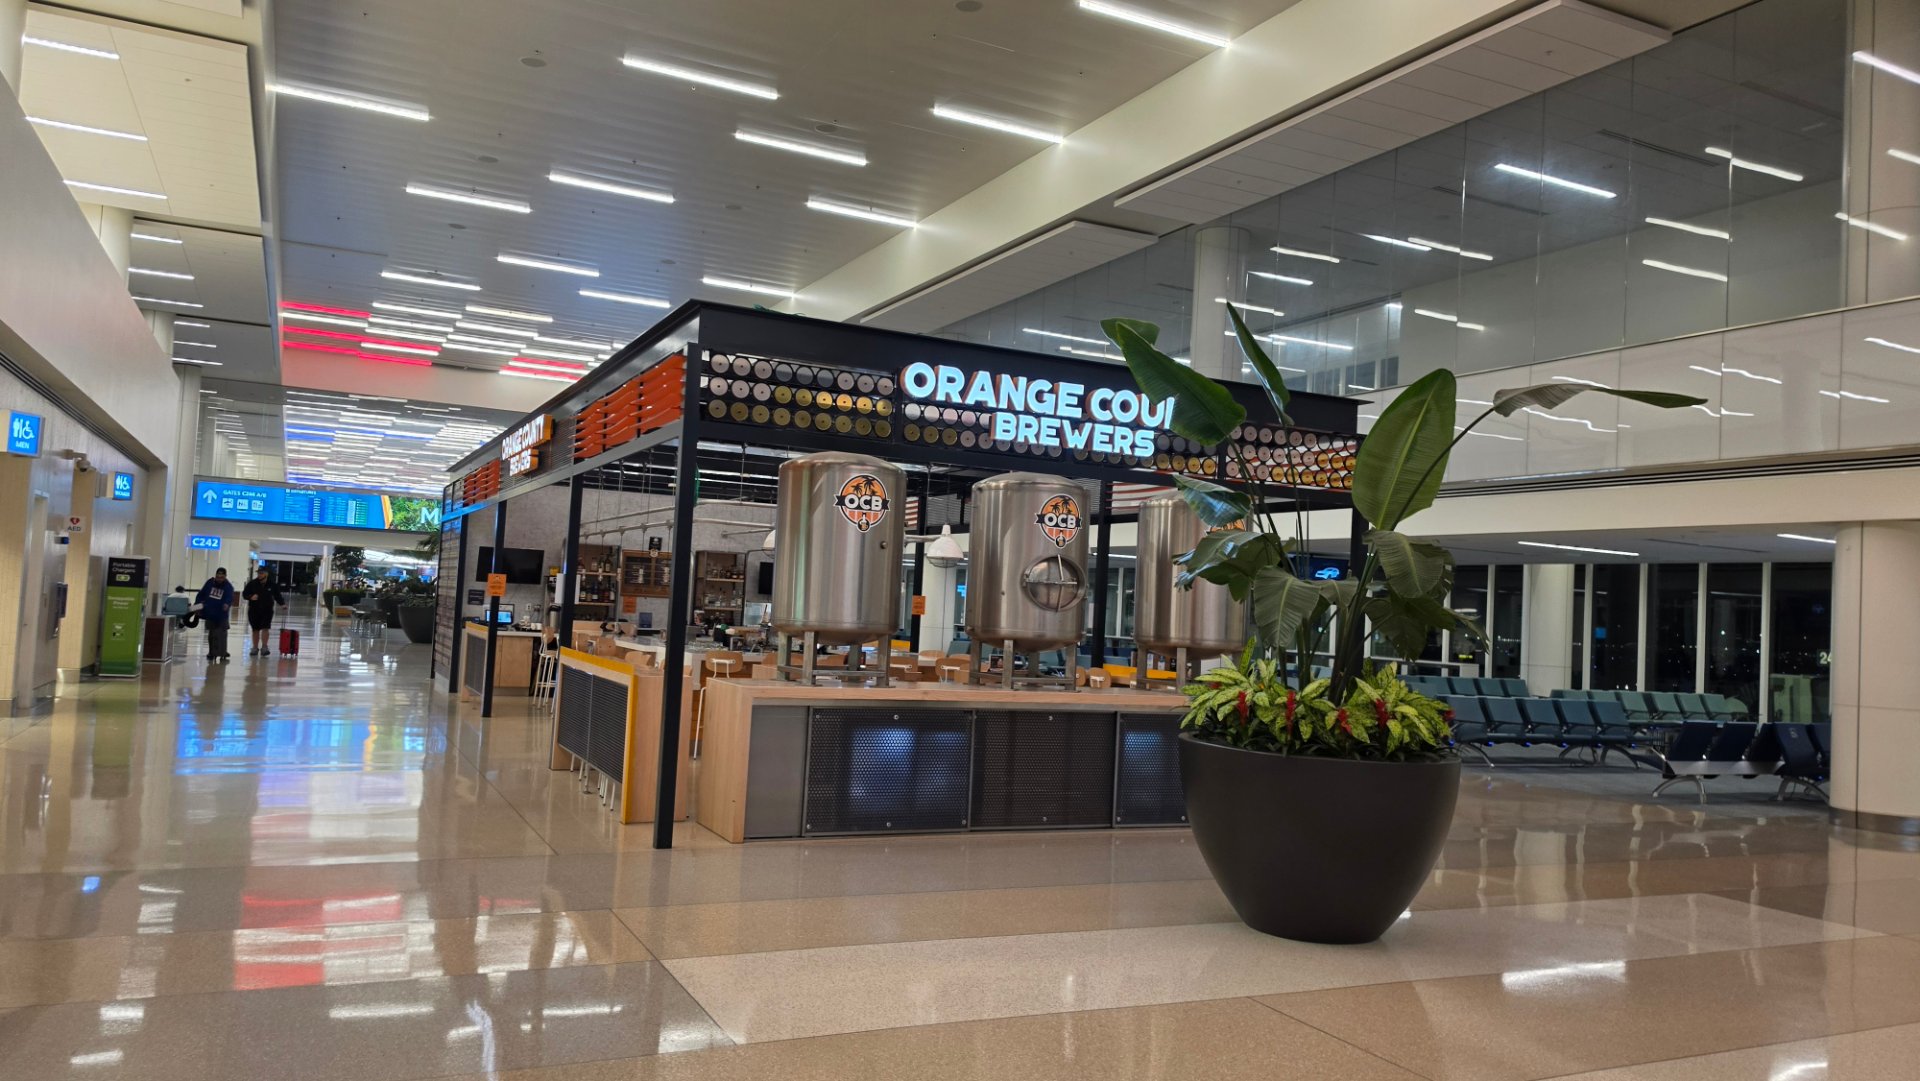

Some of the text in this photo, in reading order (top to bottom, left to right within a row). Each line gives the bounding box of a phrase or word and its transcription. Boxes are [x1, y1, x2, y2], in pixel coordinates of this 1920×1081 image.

[902, 362, 1176, 430] ORANGE COU
[502, 414, 545, 460] ORANGE COUNTY
[991, 412, 1155, 457] BREWERS
[15, 440, 30, 449] MEN
[844, 493, 883, 511] OCB
[1044, 512, 1077, 529] OCB
[192, 537, 218, 547] C242
